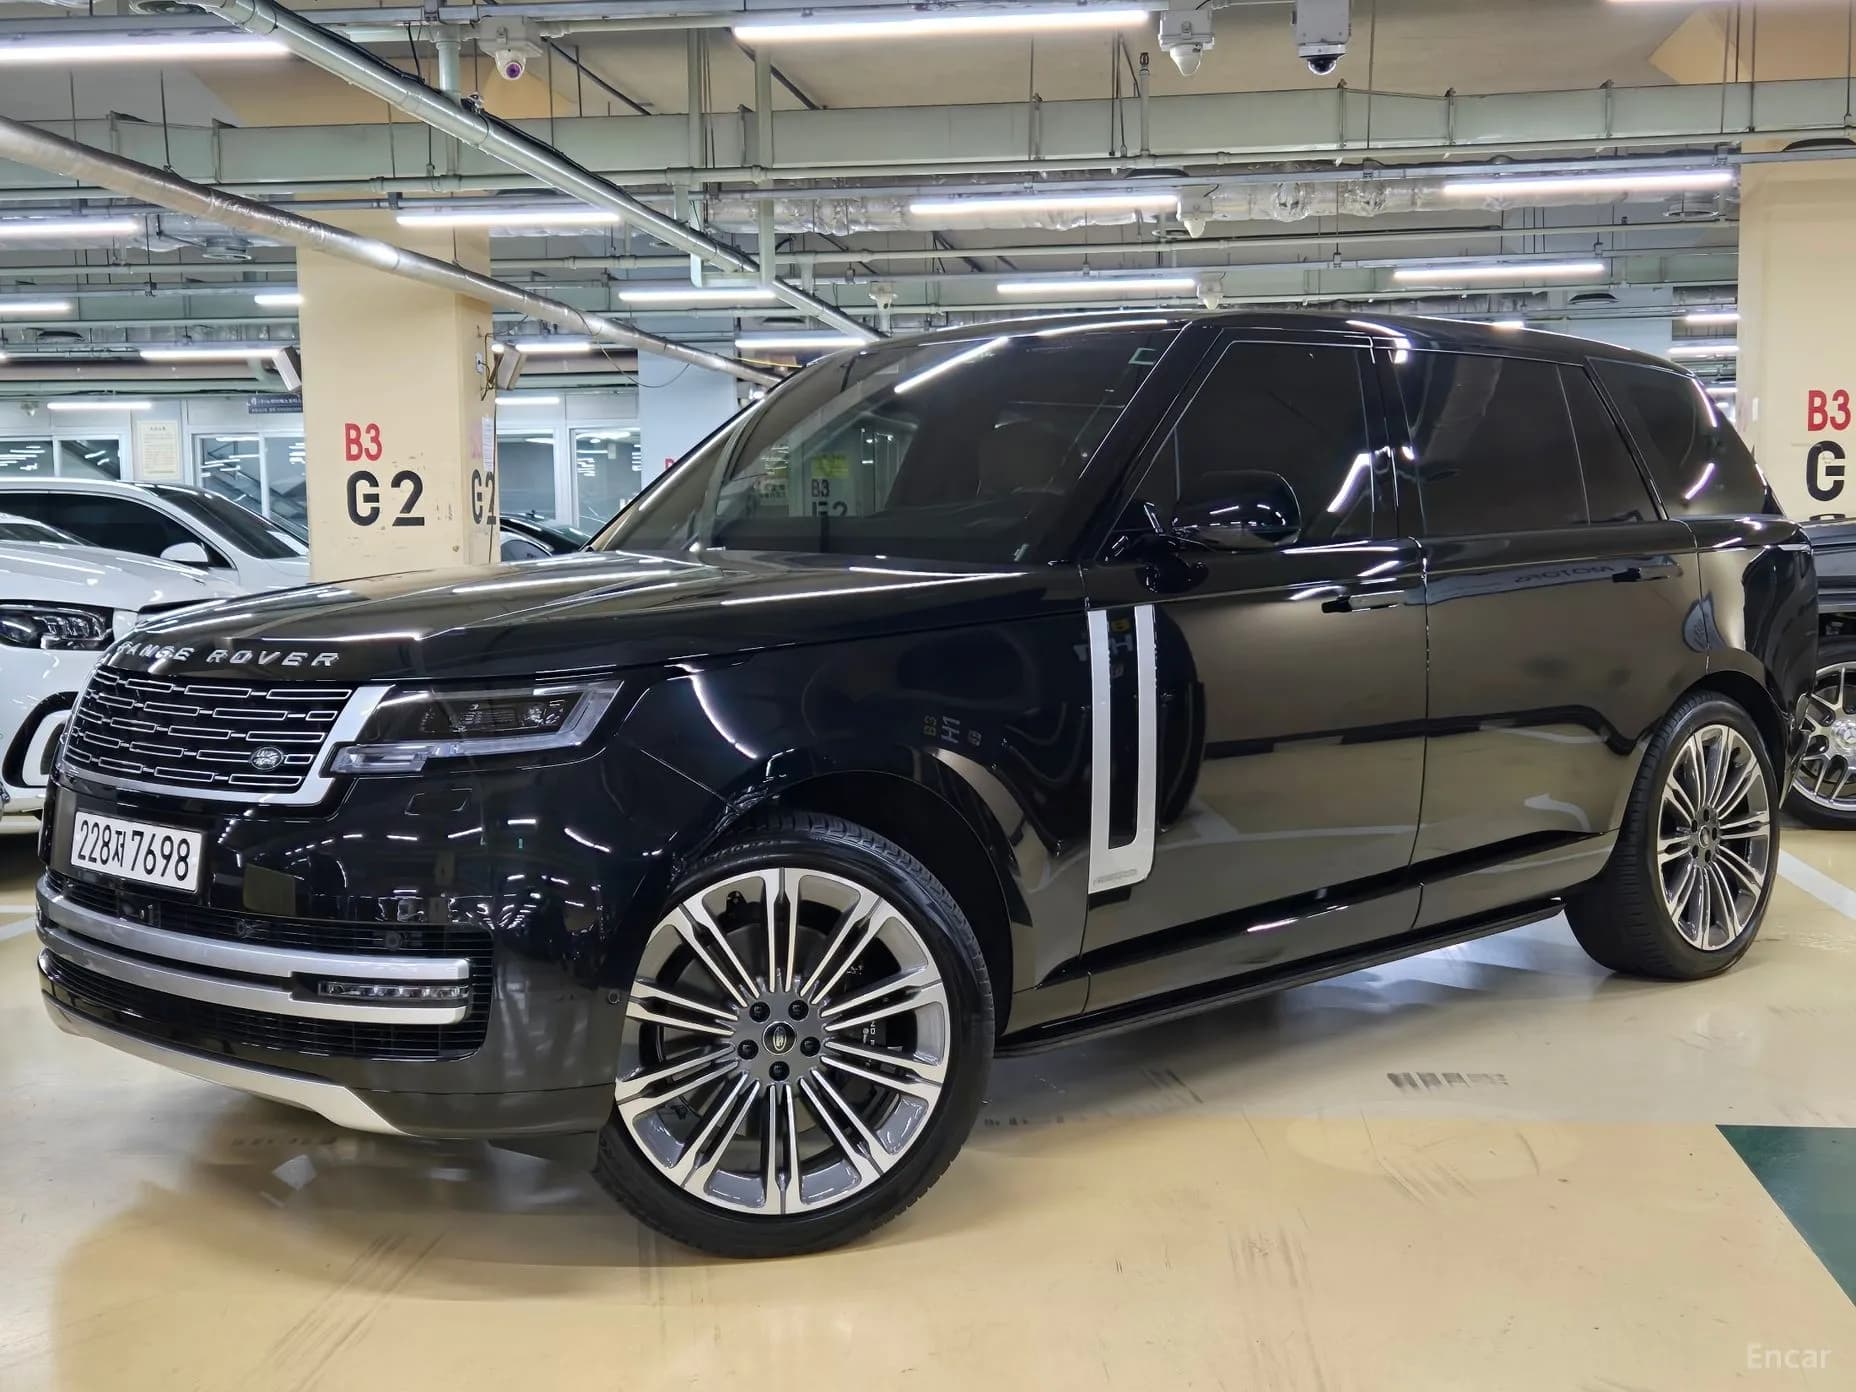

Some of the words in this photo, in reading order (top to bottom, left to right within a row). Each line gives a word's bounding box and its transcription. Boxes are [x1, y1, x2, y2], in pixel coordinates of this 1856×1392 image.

[1807, 389, 1851, 431] B3
[344, 422, 382, 461] B3
[1806, 440, 1845, 501] G
[347, 469, 425, 526] G2
[471, 468, 497, 525] G2
[205, 649, 339, 667] ROVER
